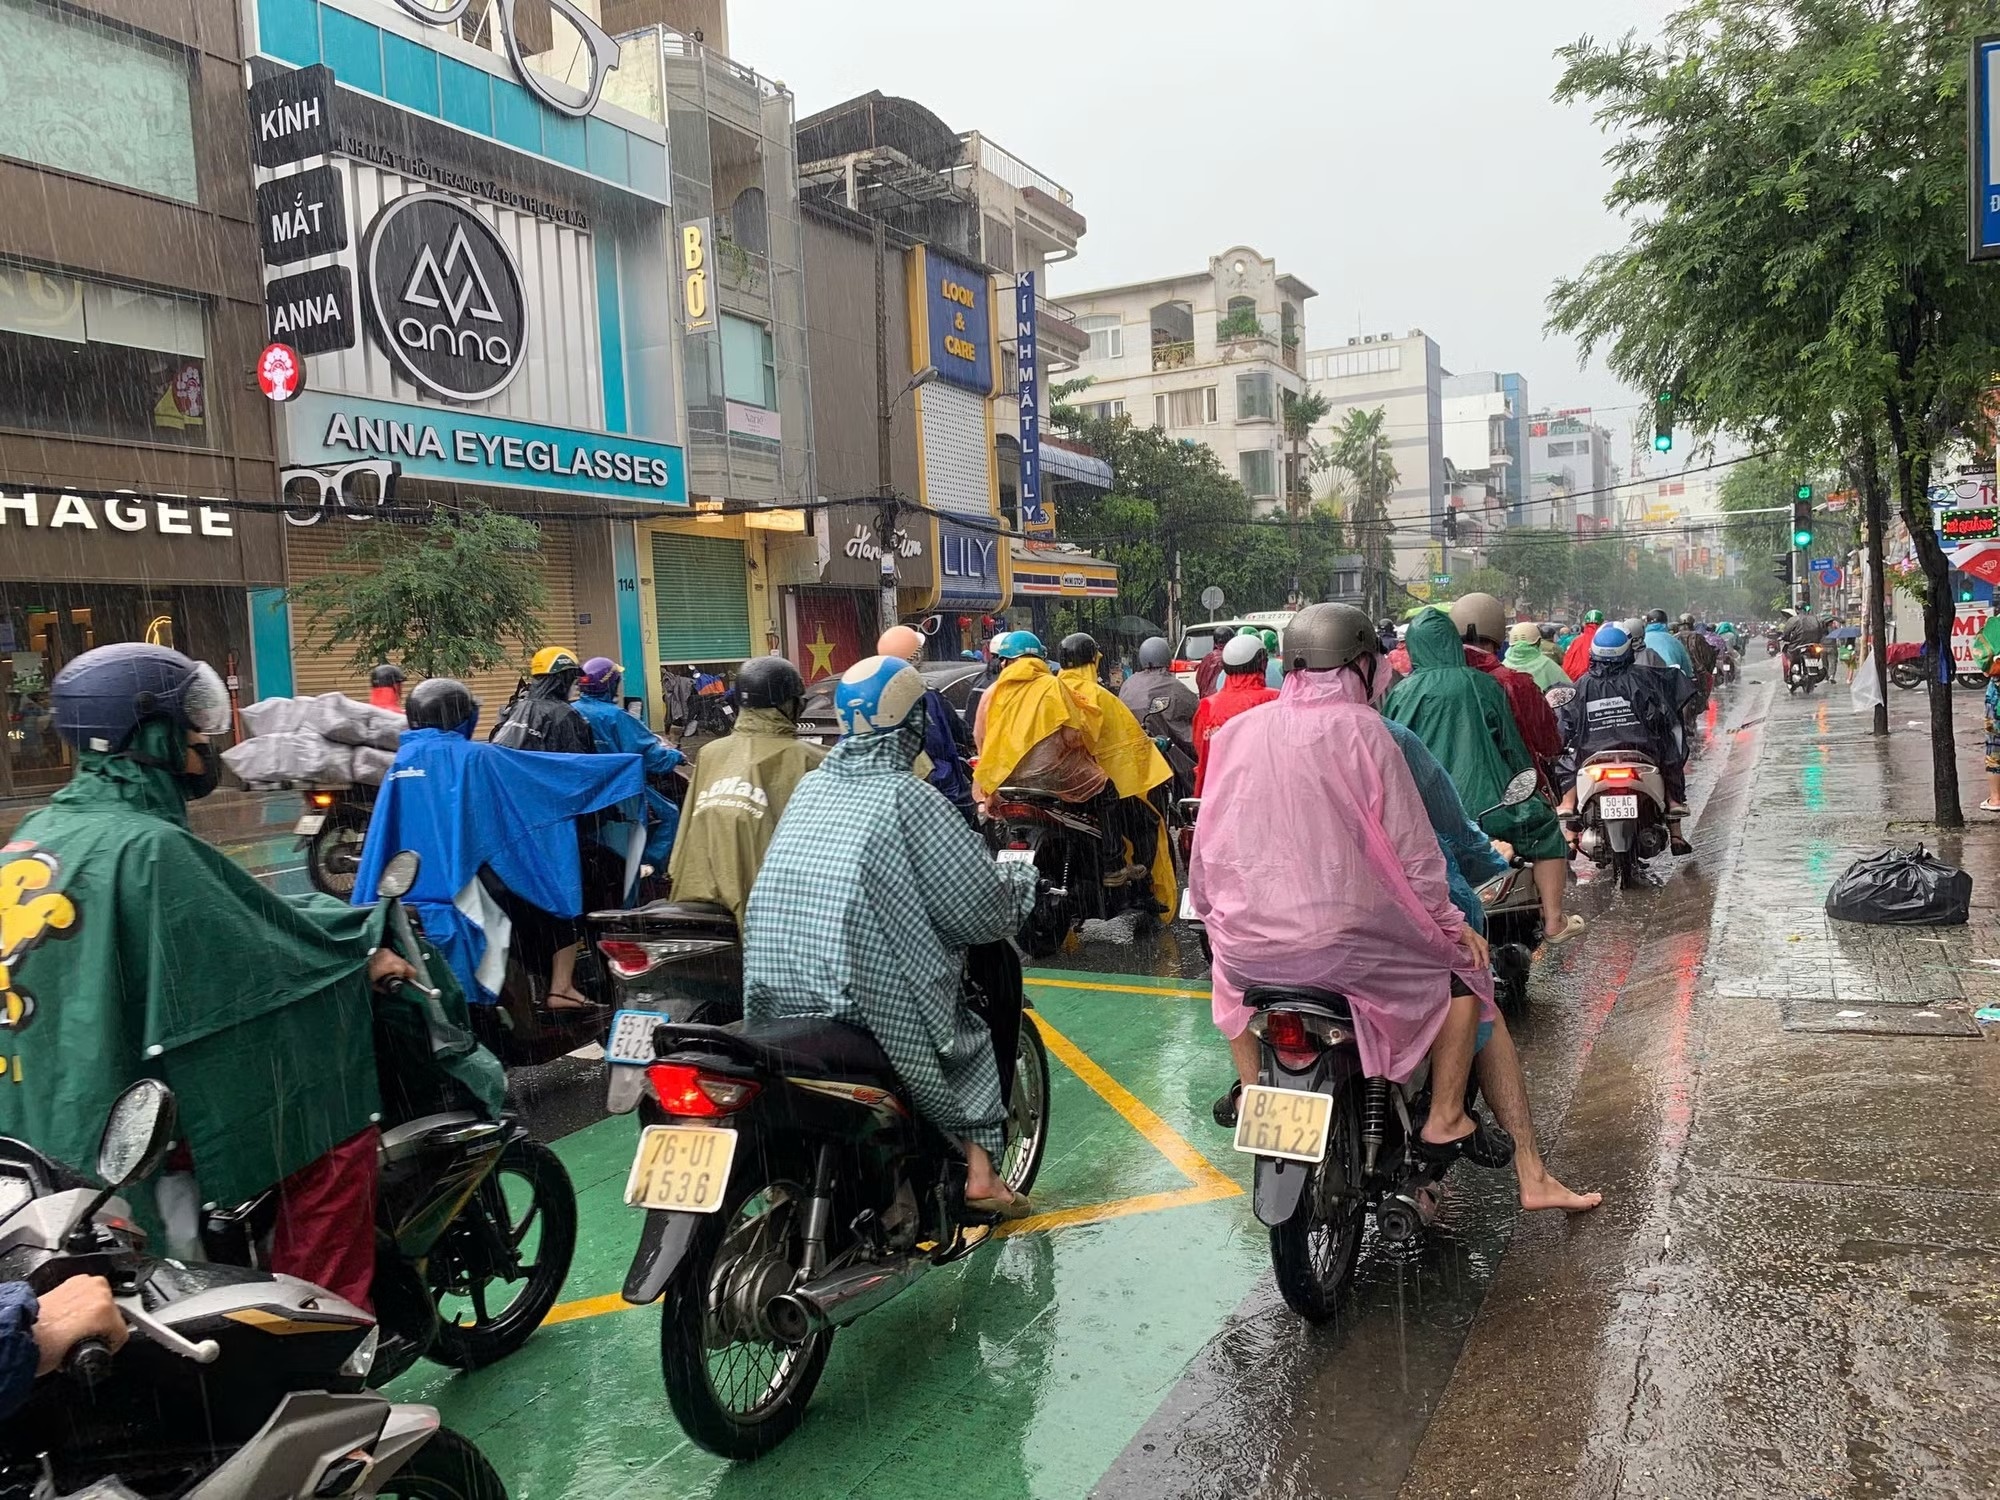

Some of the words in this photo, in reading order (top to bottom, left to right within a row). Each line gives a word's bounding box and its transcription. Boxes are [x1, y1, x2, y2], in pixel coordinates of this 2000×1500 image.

[261, 97, 320, 141] KÍNH
[436, 167, 480, 194] TRANG
[272, 191, 325, 243] MẮT
[941, 278, 975, 309] LOOK
[272, 292, 341, 335] ANNA
[954, 311, 966, 332] &
[1016, 271, 1033, 361] KÍNH
[398, 317, 511, 366] anna
[943, 334, 976, 363] CARE
[1018, 366, 1035, 431] MẮT
[325, 412, 447, 460] ANNA
[454, 430, 669, 488] EYEGLASSES
[1021, 437, 1038, 521] LILY
[944, 535, 994, 577] LILY
[618, 578, 635, 592] 114
[1952, 609, 1988, 637] MÌ
[1604, 807, 1635, 818] 035.30
[1606, 796, 1632, 807] 50-AC
[613, 1037, 655, 1060] 5423
[1254, 1092, 1315, 1125] 84-C1
[650, 1133, 717, 1167] 76-U1
[1243, 1119, 1321, 1154] 161.22
[641, 1169, 710, 1204] 1536
